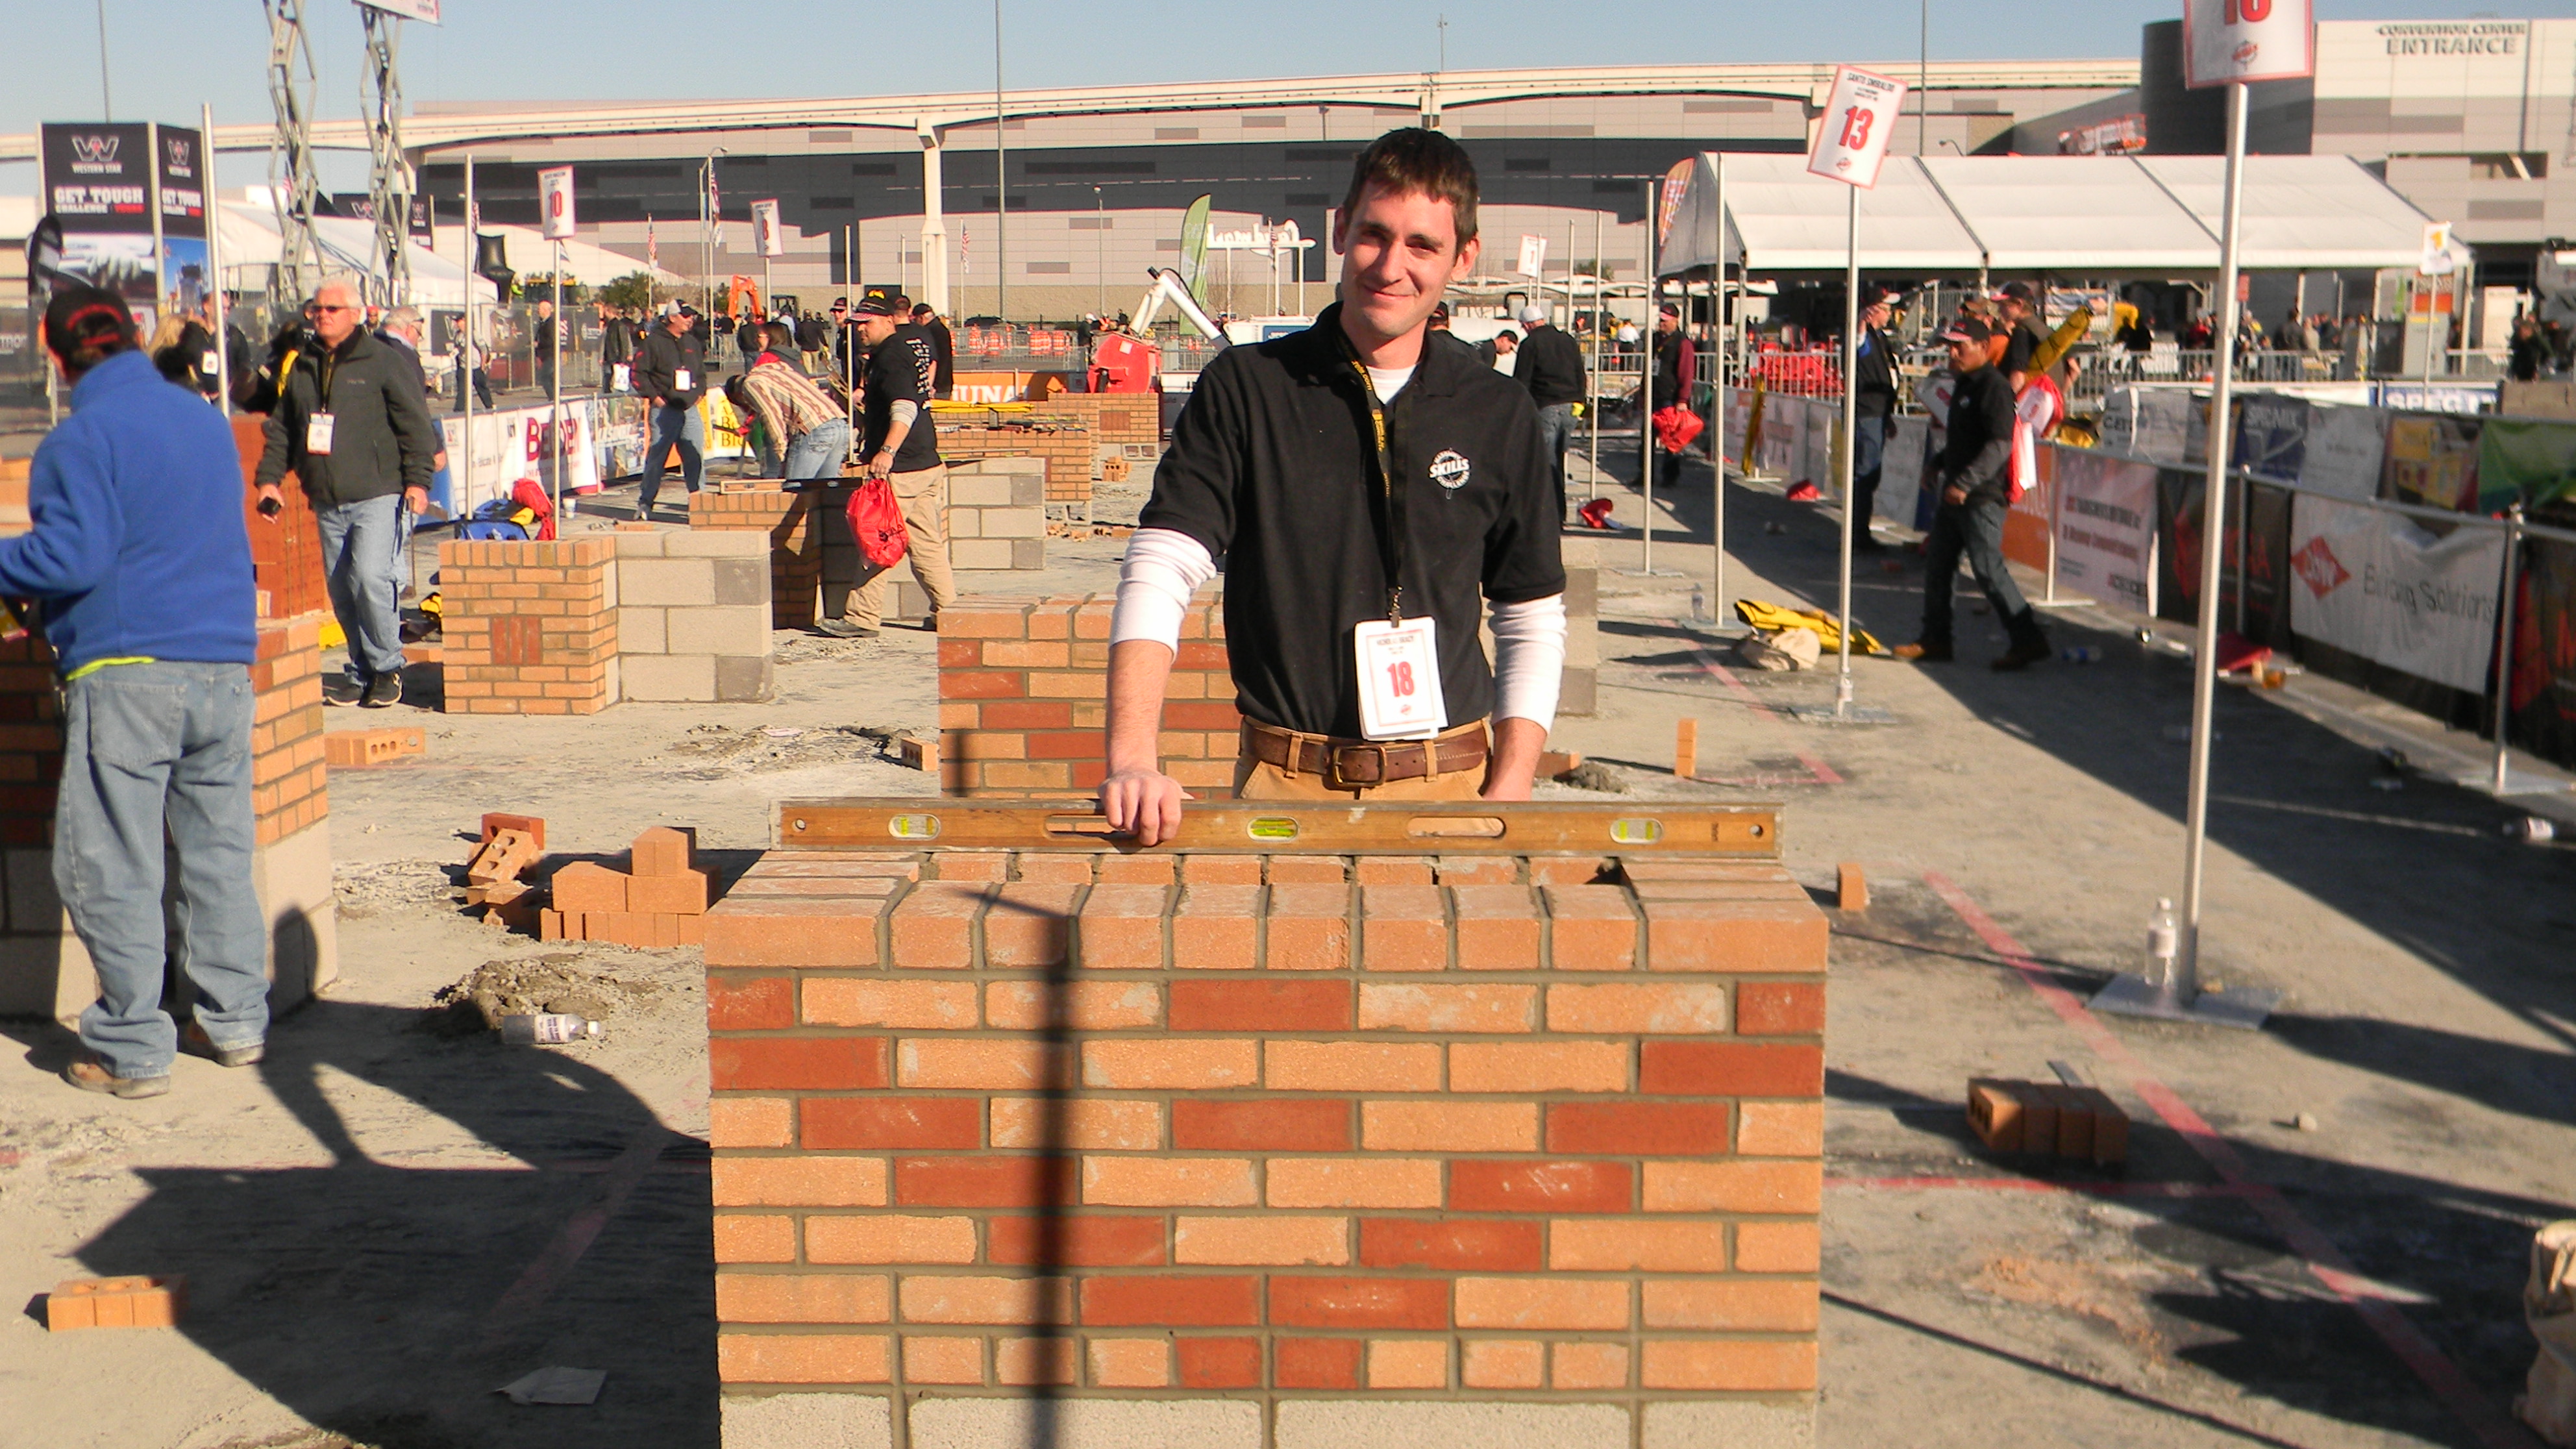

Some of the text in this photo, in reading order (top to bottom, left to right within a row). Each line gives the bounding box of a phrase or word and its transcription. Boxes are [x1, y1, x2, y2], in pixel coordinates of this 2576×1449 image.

[2375, 23, 2525, 36] CONVENTION CENTER
[2386, 37, 2517, 55] ENTRANCE
[1839, 105, 1874, 150] 13
[105, 162, 122, 174] STAR
[55, 186, 143, 204] GET TOUGH
[549, 190, 562, 219] 10
[1429, 458, 1470, 478] SKILLS
[1387, 661, 1415, 697] 18
